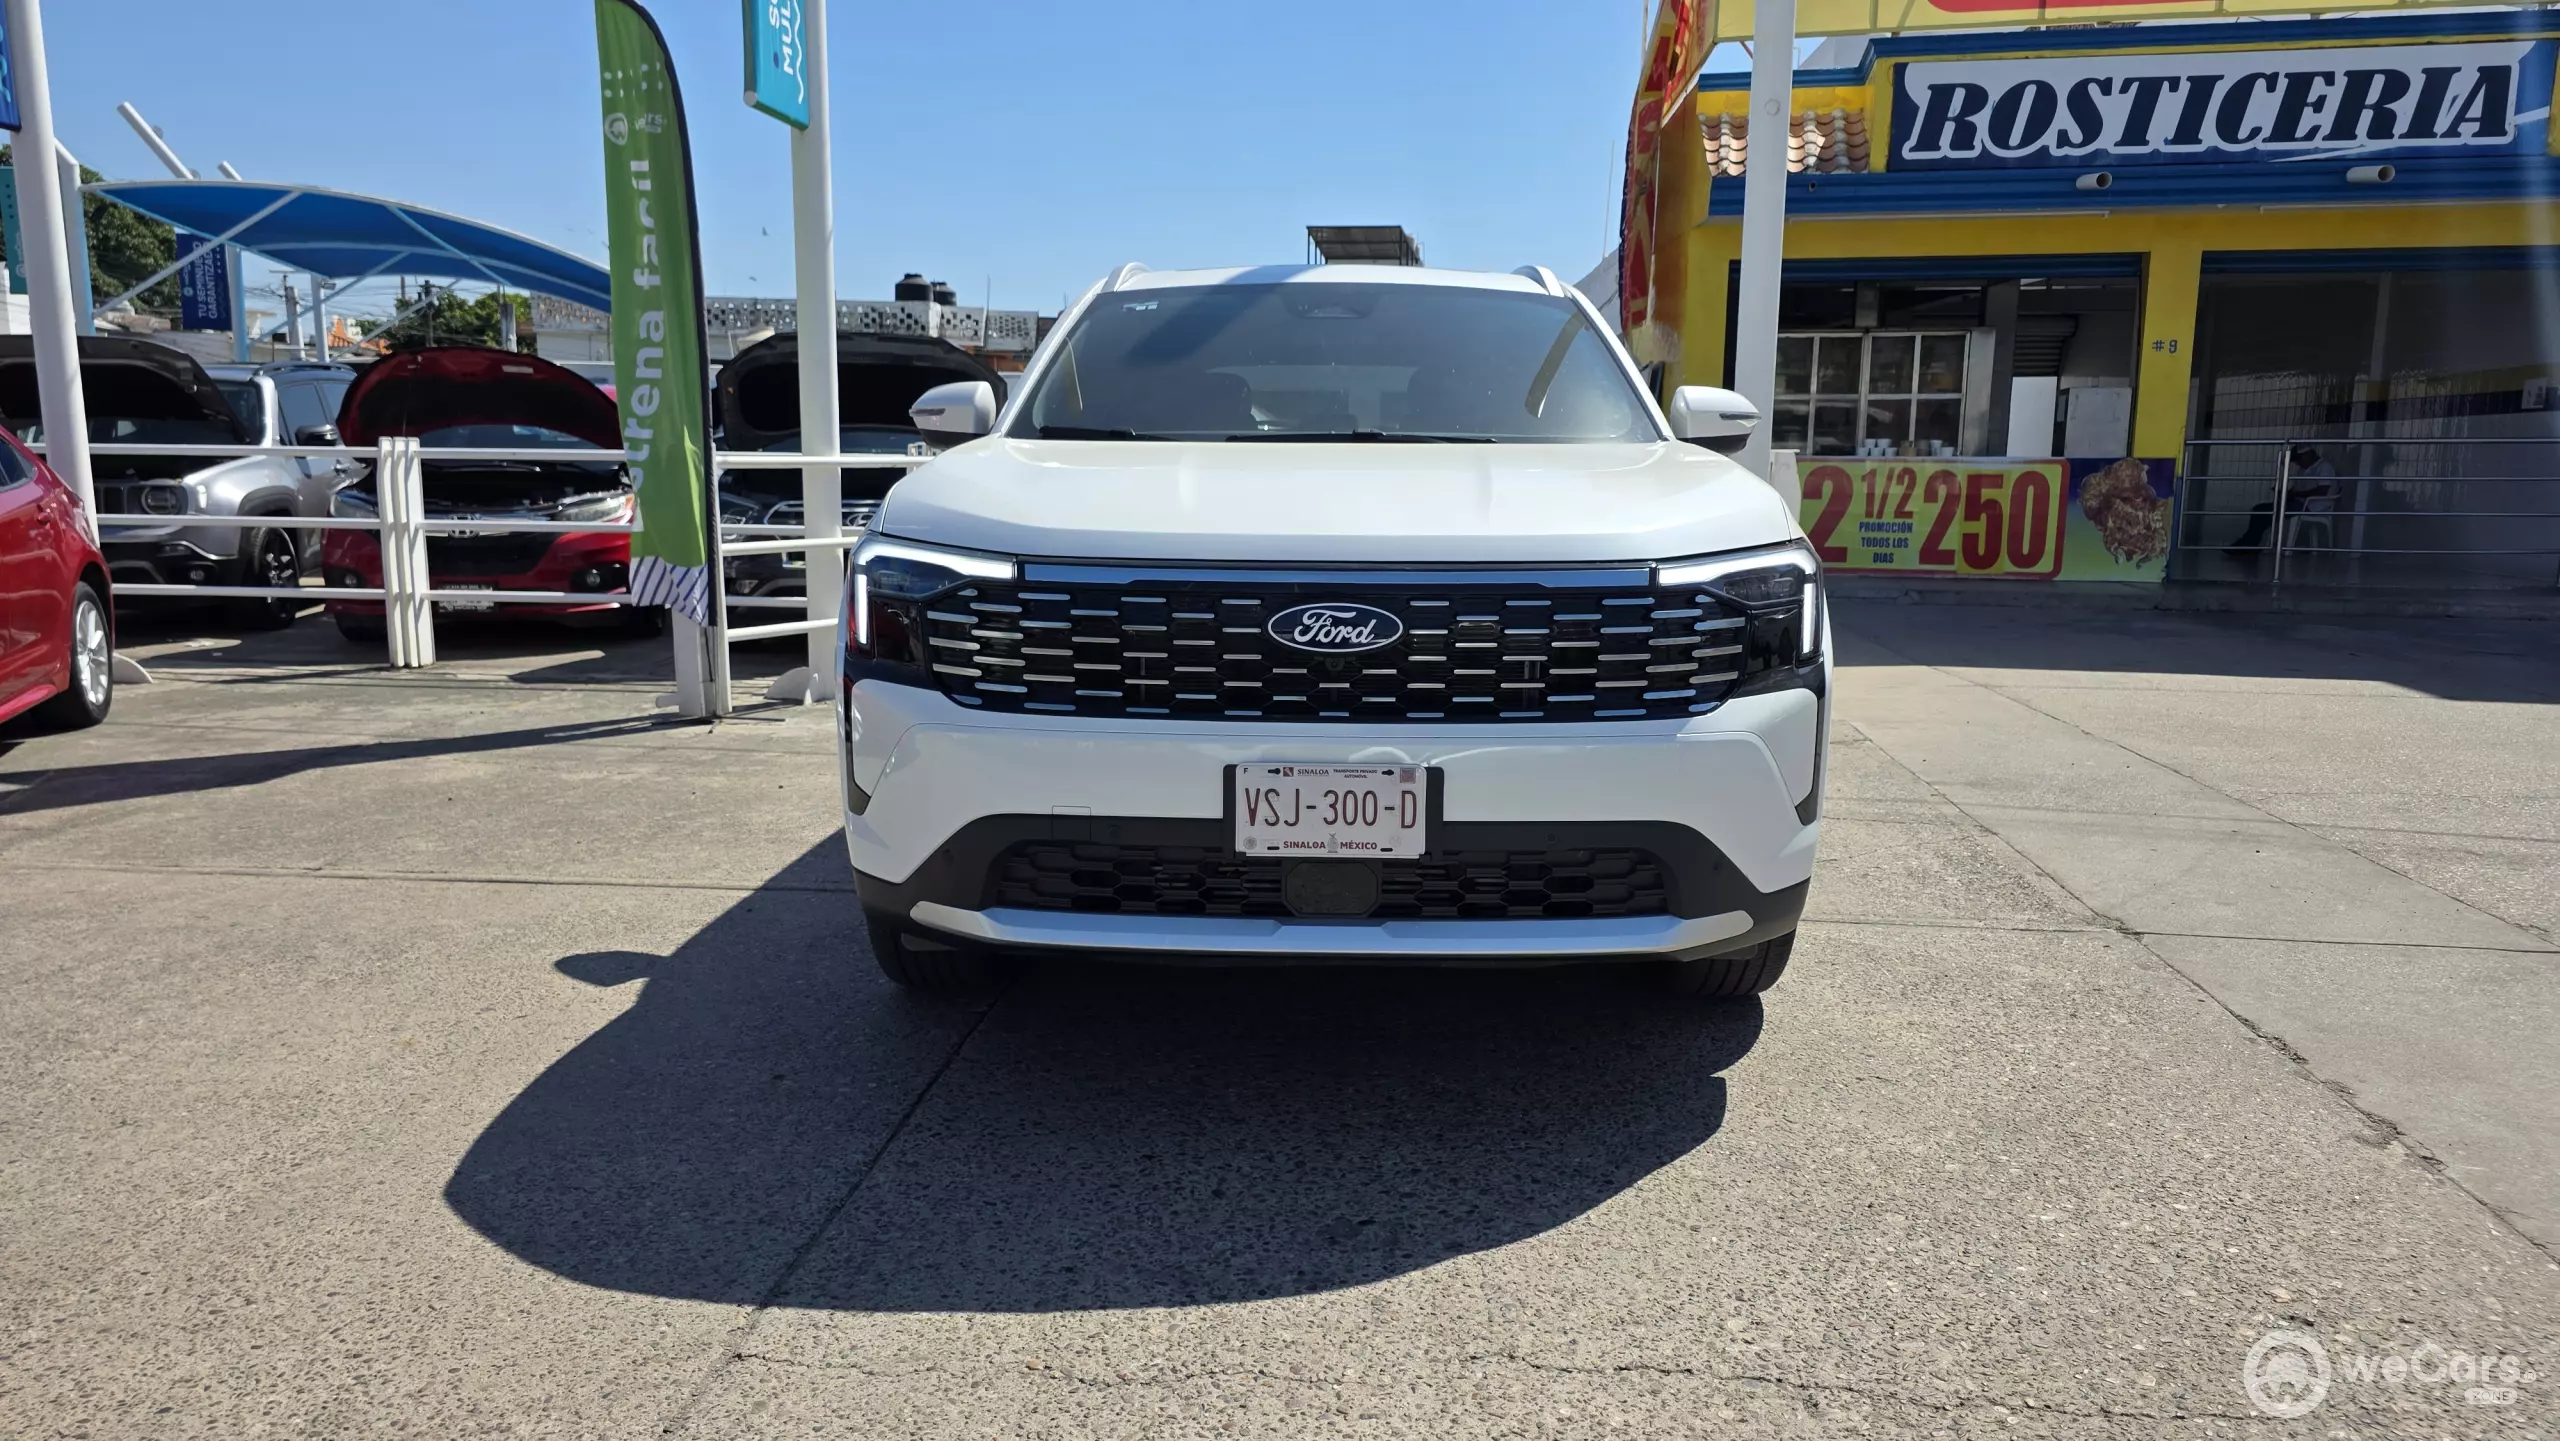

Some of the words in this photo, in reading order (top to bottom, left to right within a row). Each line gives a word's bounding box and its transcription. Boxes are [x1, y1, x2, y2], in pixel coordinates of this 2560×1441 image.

[1907, 64, 2512, 154] ROSTICERIA
[193, 241, 206, 301] SEMINUEO
[203, 241, 217, 319] GARANTIZAD
[198, 304, 207, 318] TU
[1803, 466, 1854, 563] 2
[1861, 467, 1917, 520] 1/2
[1919, 470, 2051, 570] 250
[1859, 521, 1913, 533] PROMOCIÓN
[1861, 537, 1890, 548] TODOS
[1892, 537, 1909, 548] LOS
[1293, 609, 1393, 644] Ford
[1244, 787, 1417, 829] VSJ-300-D
[1283, 841, 1326, 849] SINALOA
[1340, 840, 1378, 850] MÉXICO
